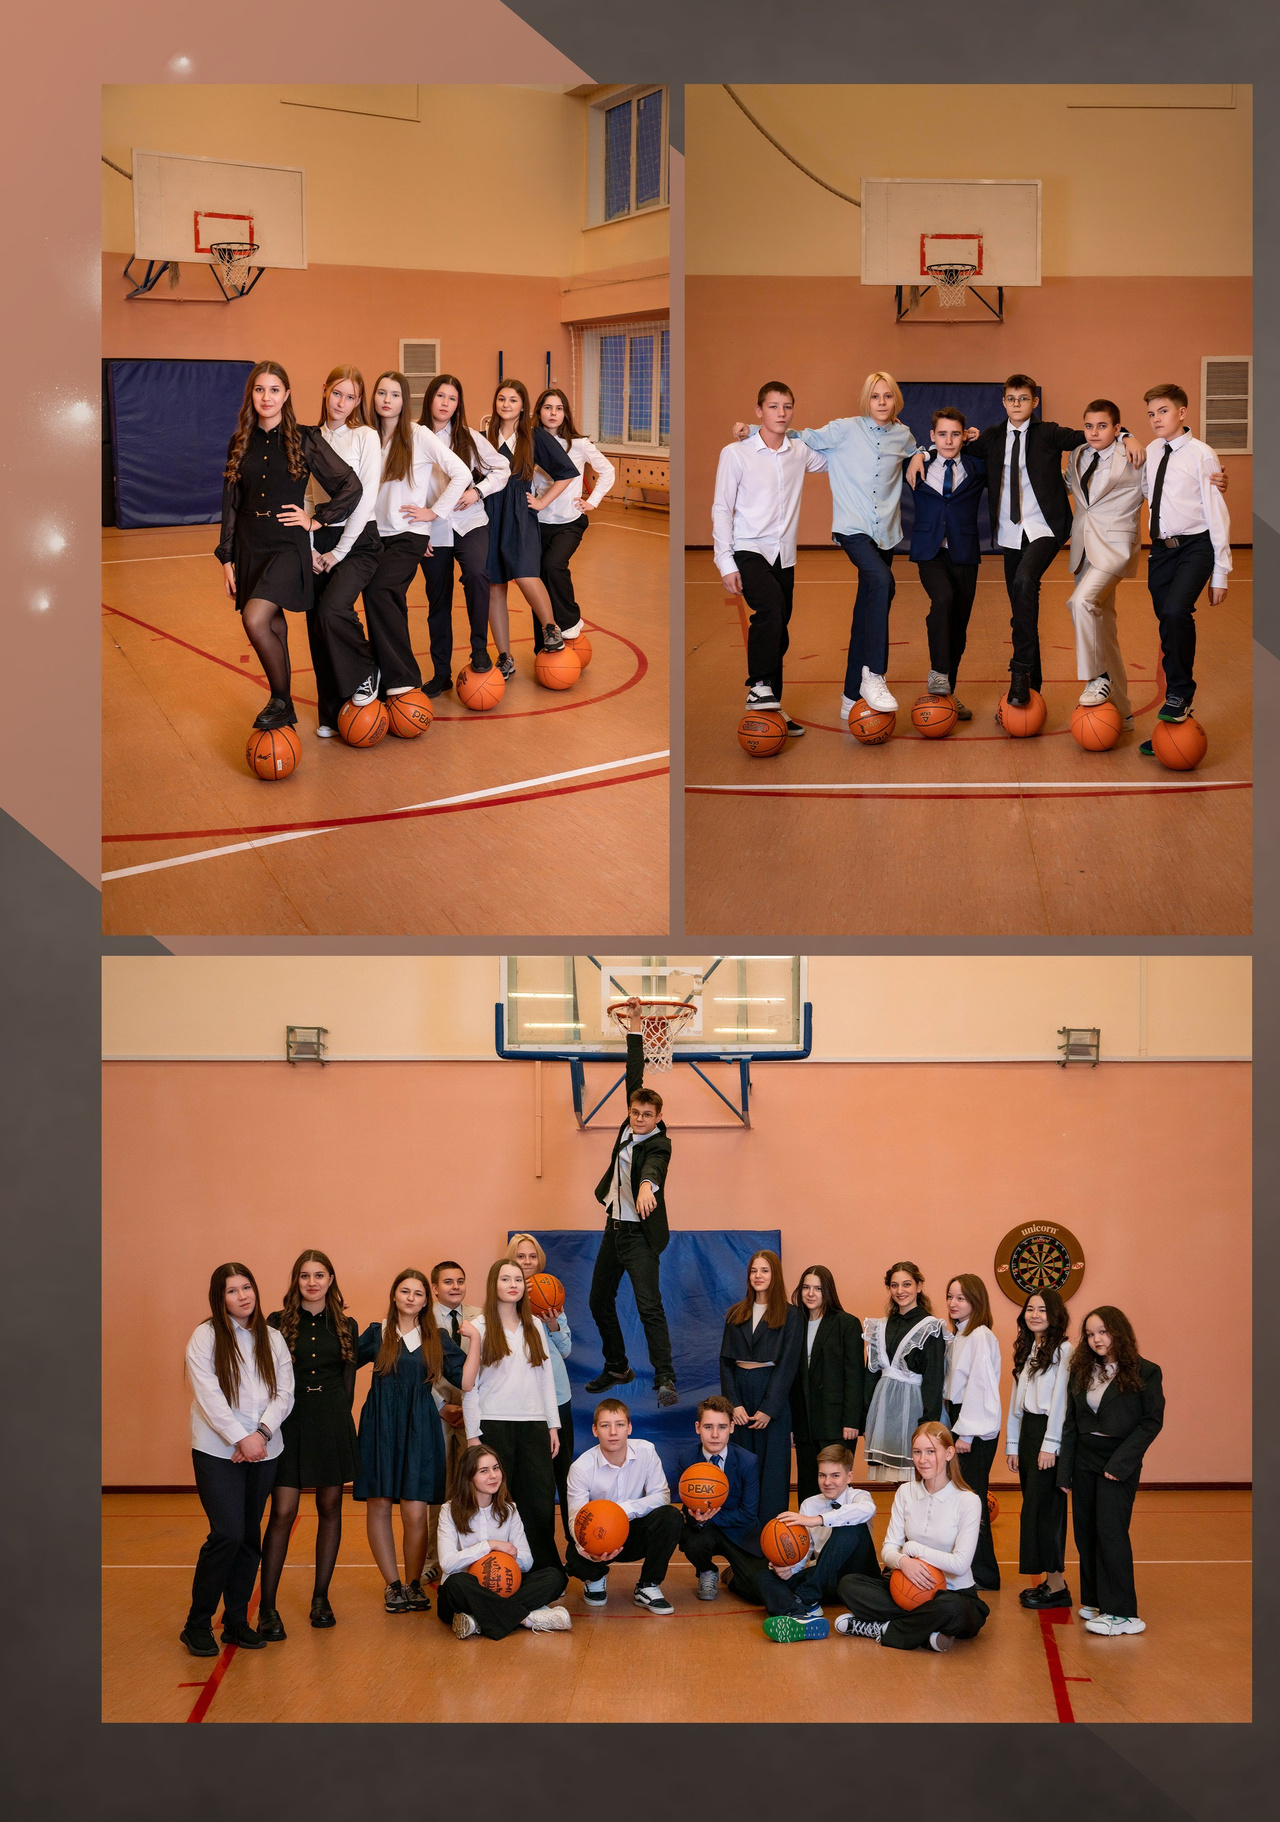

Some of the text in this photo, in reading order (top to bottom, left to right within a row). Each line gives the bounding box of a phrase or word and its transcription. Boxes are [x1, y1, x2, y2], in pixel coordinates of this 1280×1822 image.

[1021, 1223, 1057, 1236] unicorn
[687, 1483, 715, 1494] PEAK
[504, 1566, 514, 1593] ATEMI
